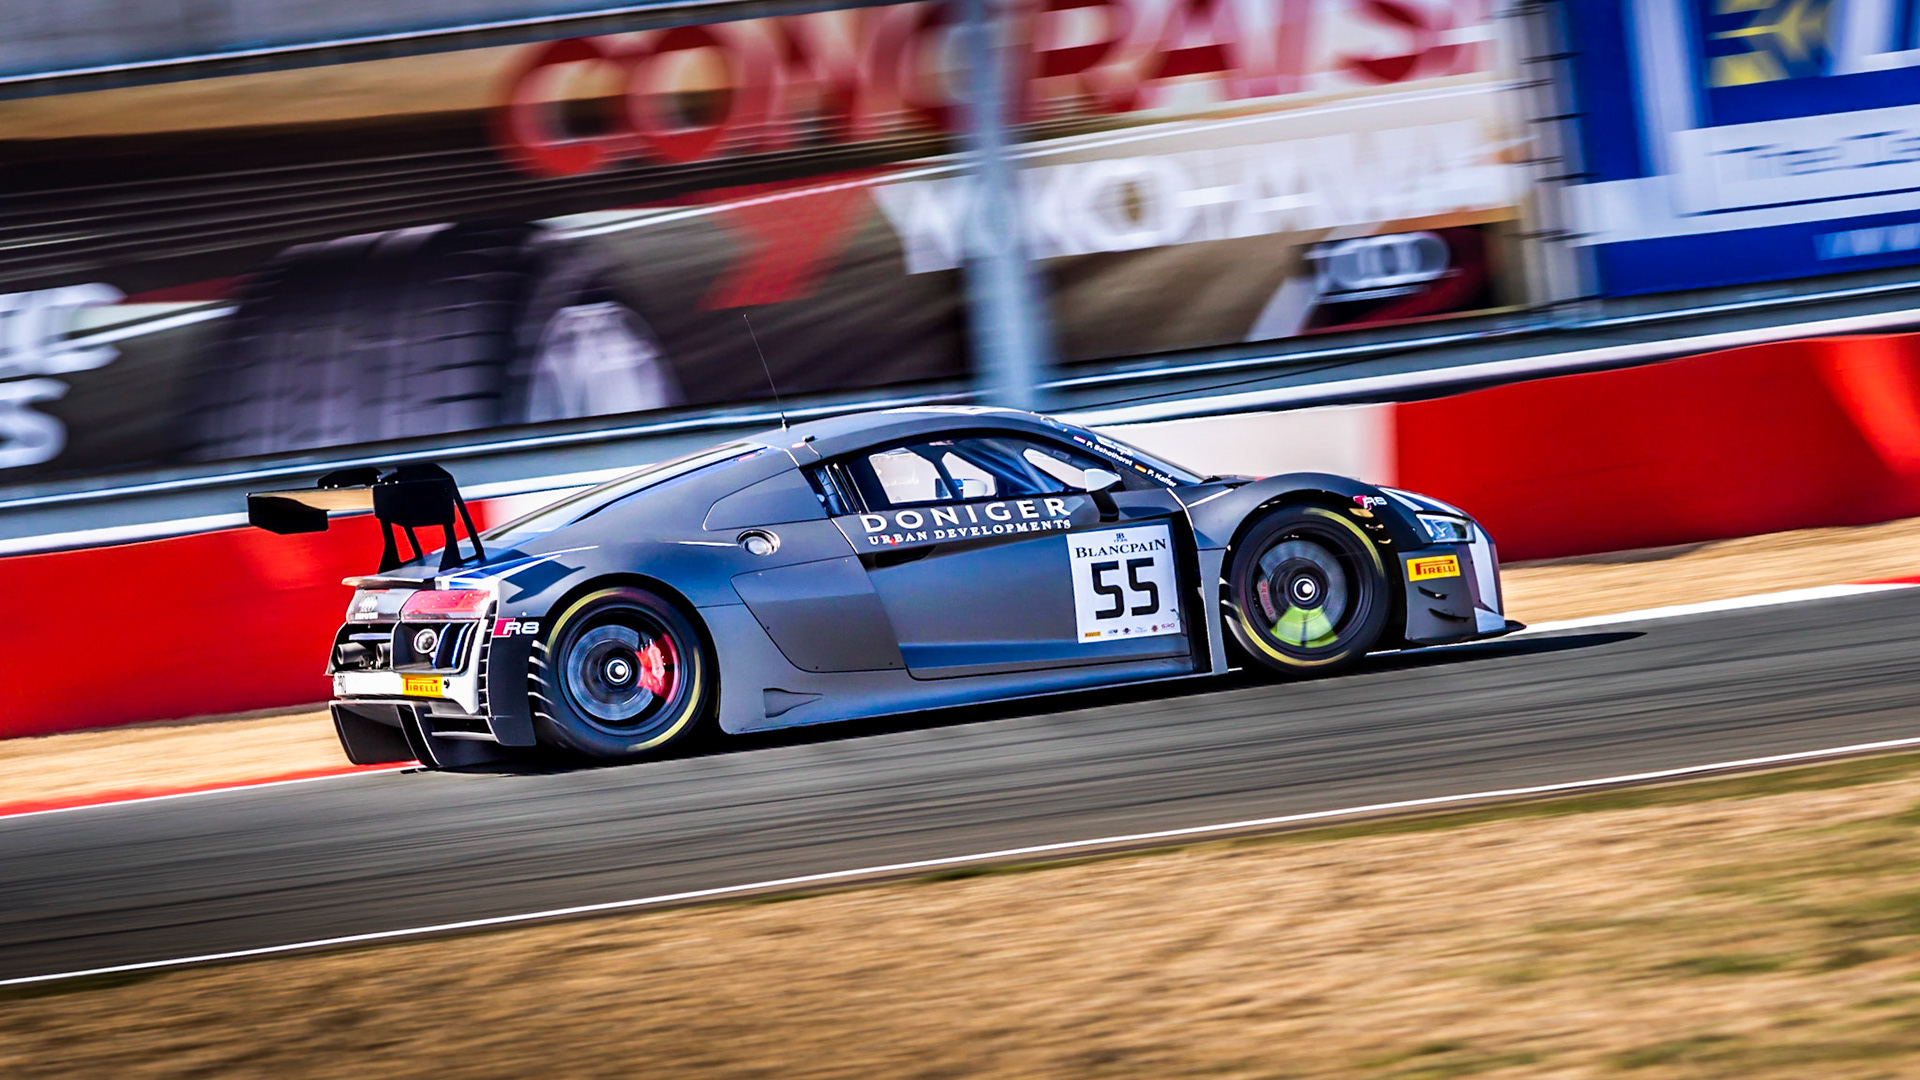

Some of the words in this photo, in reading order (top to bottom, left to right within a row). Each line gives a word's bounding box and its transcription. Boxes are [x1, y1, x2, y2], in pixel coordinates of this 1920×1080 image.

[859, 498, 1072, 533] DONIGER
[868, 531, 928, 546] URBAN
[935, 519, 1072, 540] DEVELOPMENTS
[1075, 538, 1167, 558] BLANCPAIN
[1415, 559, 1456, 576] PIRELLI
[1090, 556, 1160, 620] 55
[502, 621, 540, 635] R8
[405, 677, 439, 692] PIRELLI
